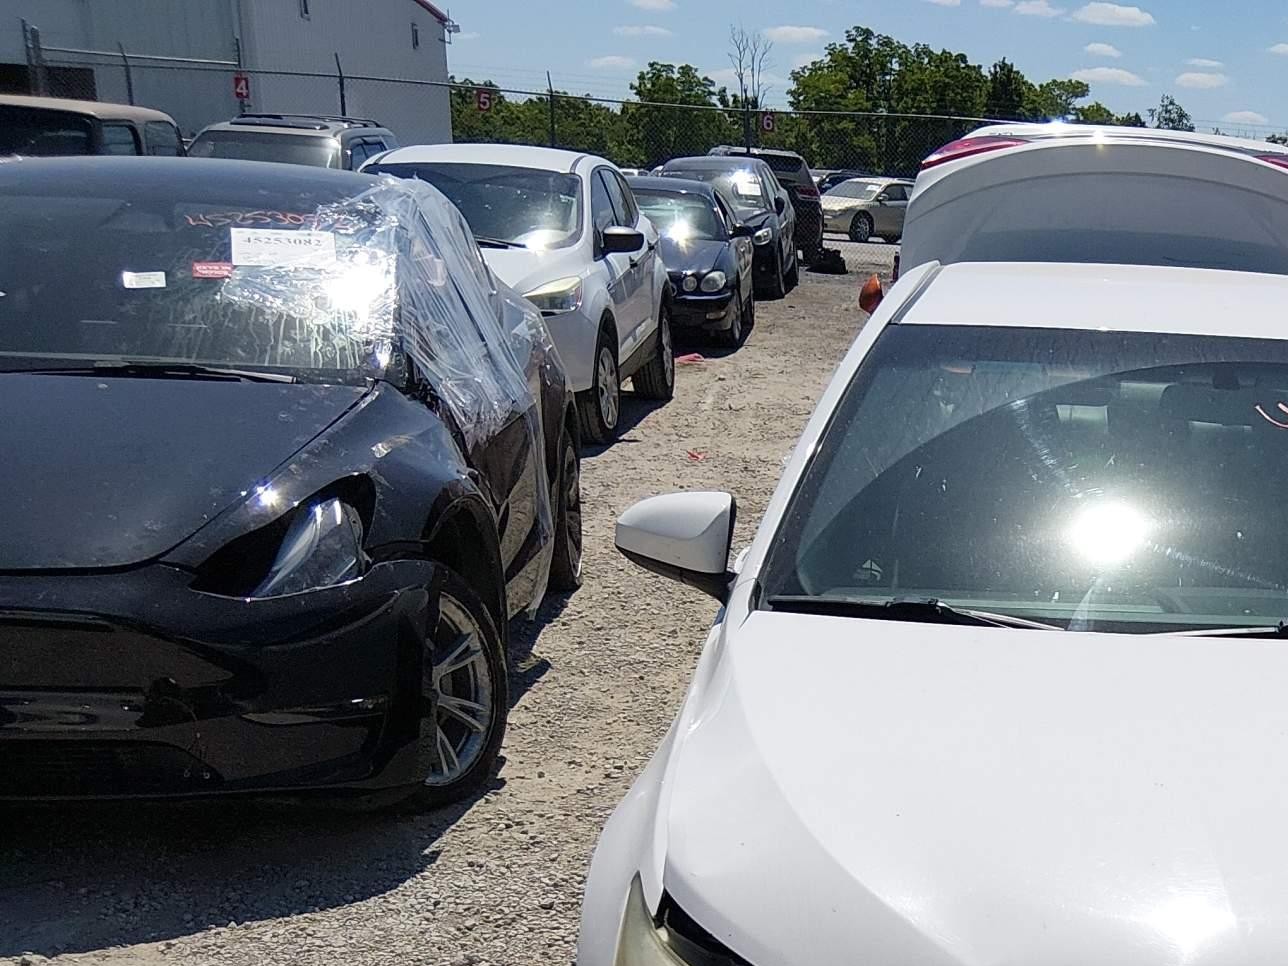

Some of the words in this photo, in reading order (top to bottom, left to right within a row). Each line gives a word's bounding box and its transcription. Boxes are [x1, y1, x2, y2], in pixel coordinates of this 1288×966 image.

[236, 81, 248, 96] 4
[479, 93, 490, 109] 5
[763, 114, 773, 130] 6
